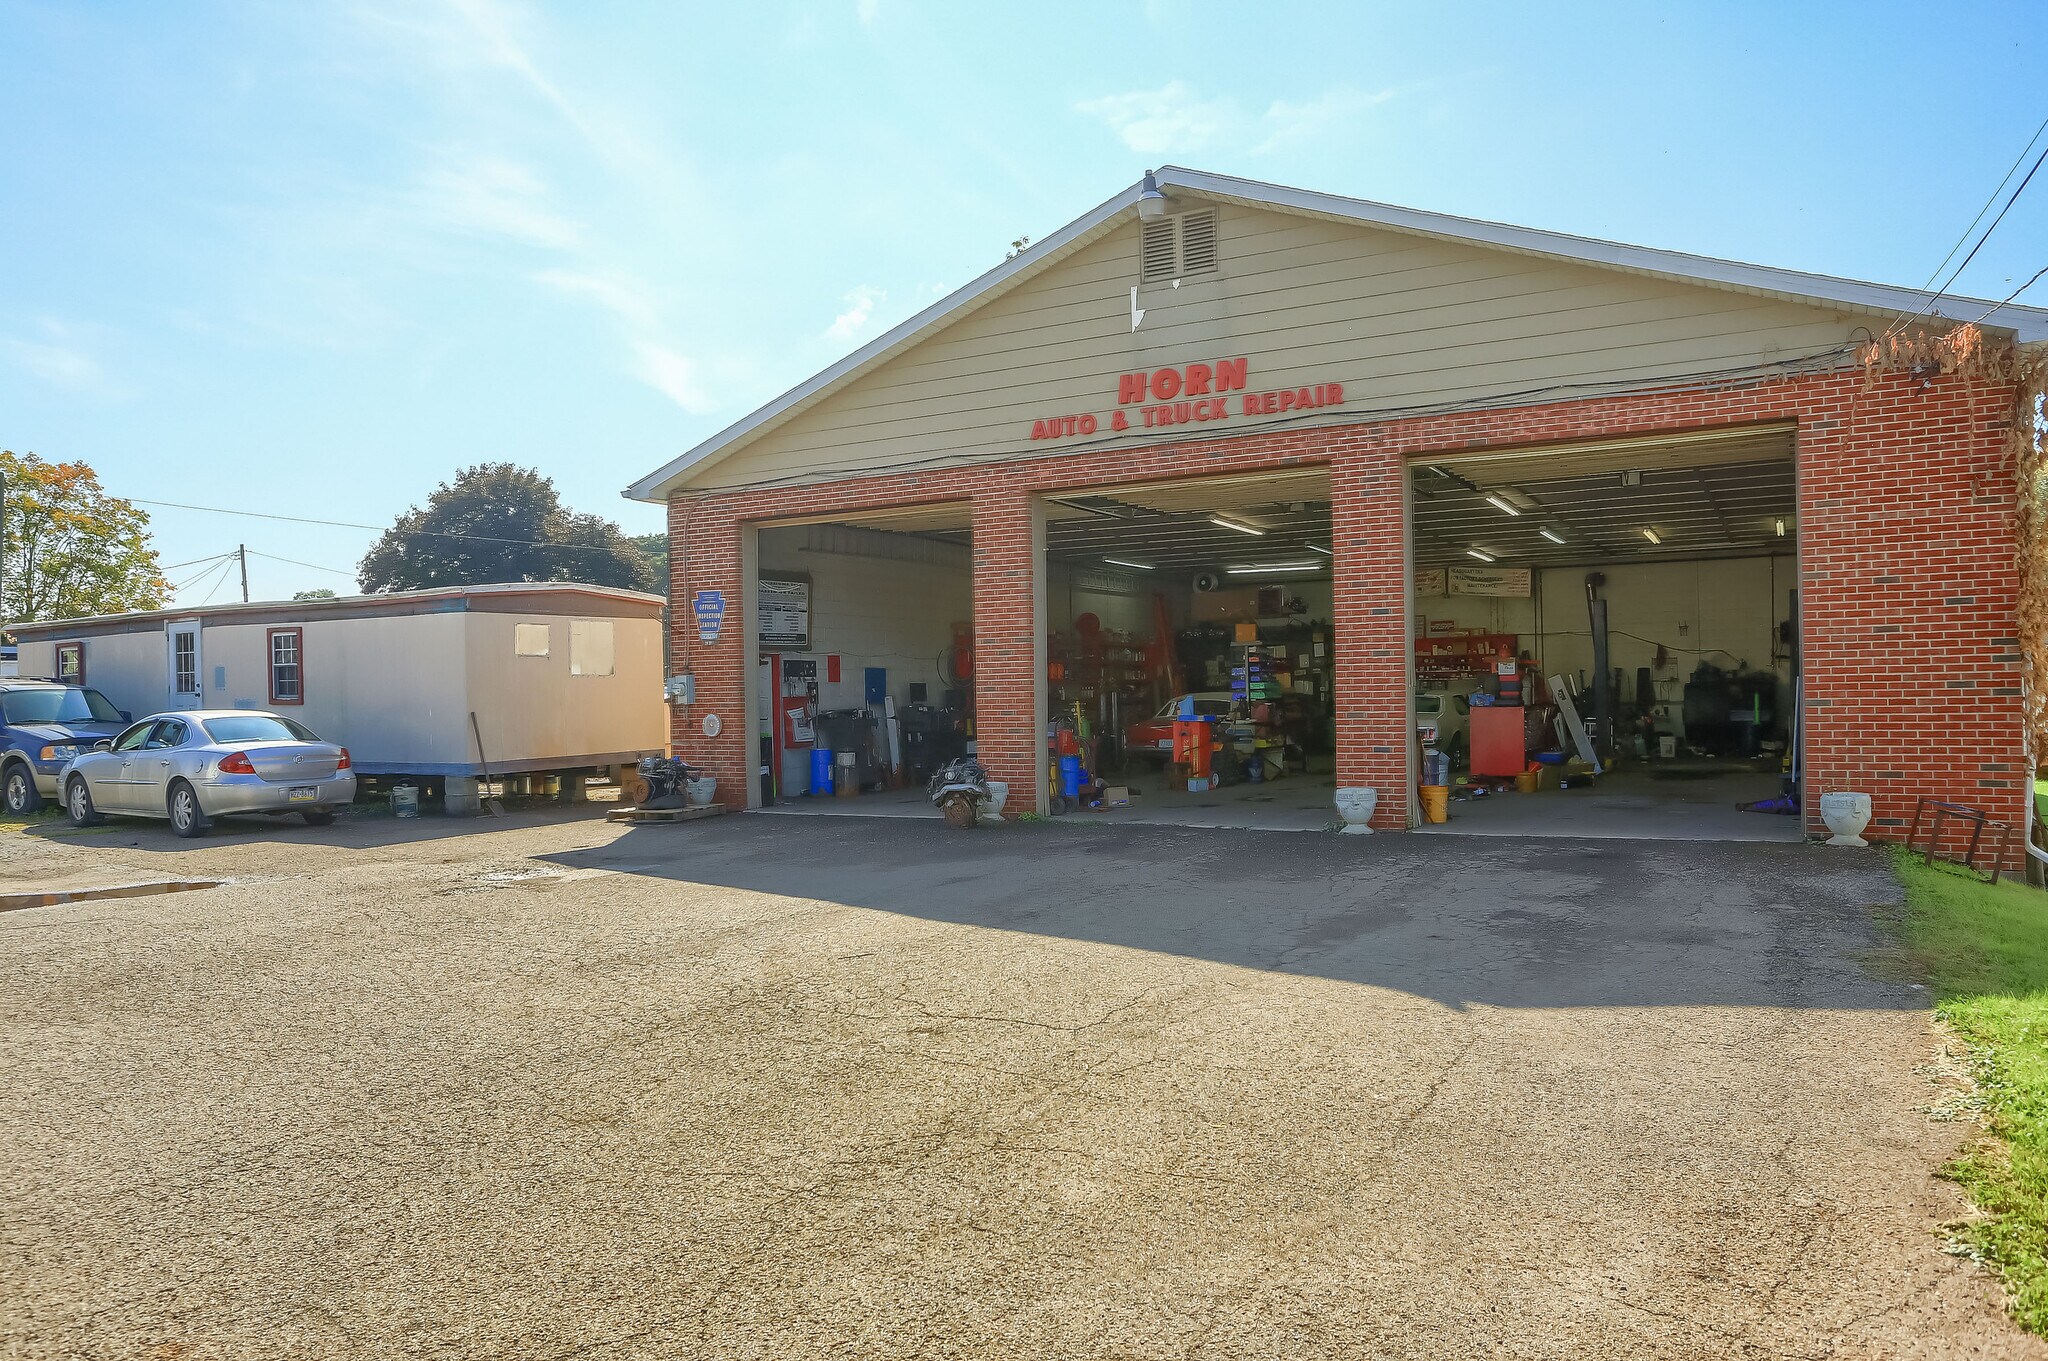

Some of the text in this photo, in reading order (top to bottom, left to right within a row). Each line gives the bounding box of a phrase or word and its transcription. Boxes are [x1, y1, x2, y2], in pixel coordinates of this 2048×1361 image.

[1118, 358, 1248, 404] HORN
[1030, 383, 1344, 440] AUTO & TRUCK REPAIR
[699, 603, 718, 611] OFFICIAL
